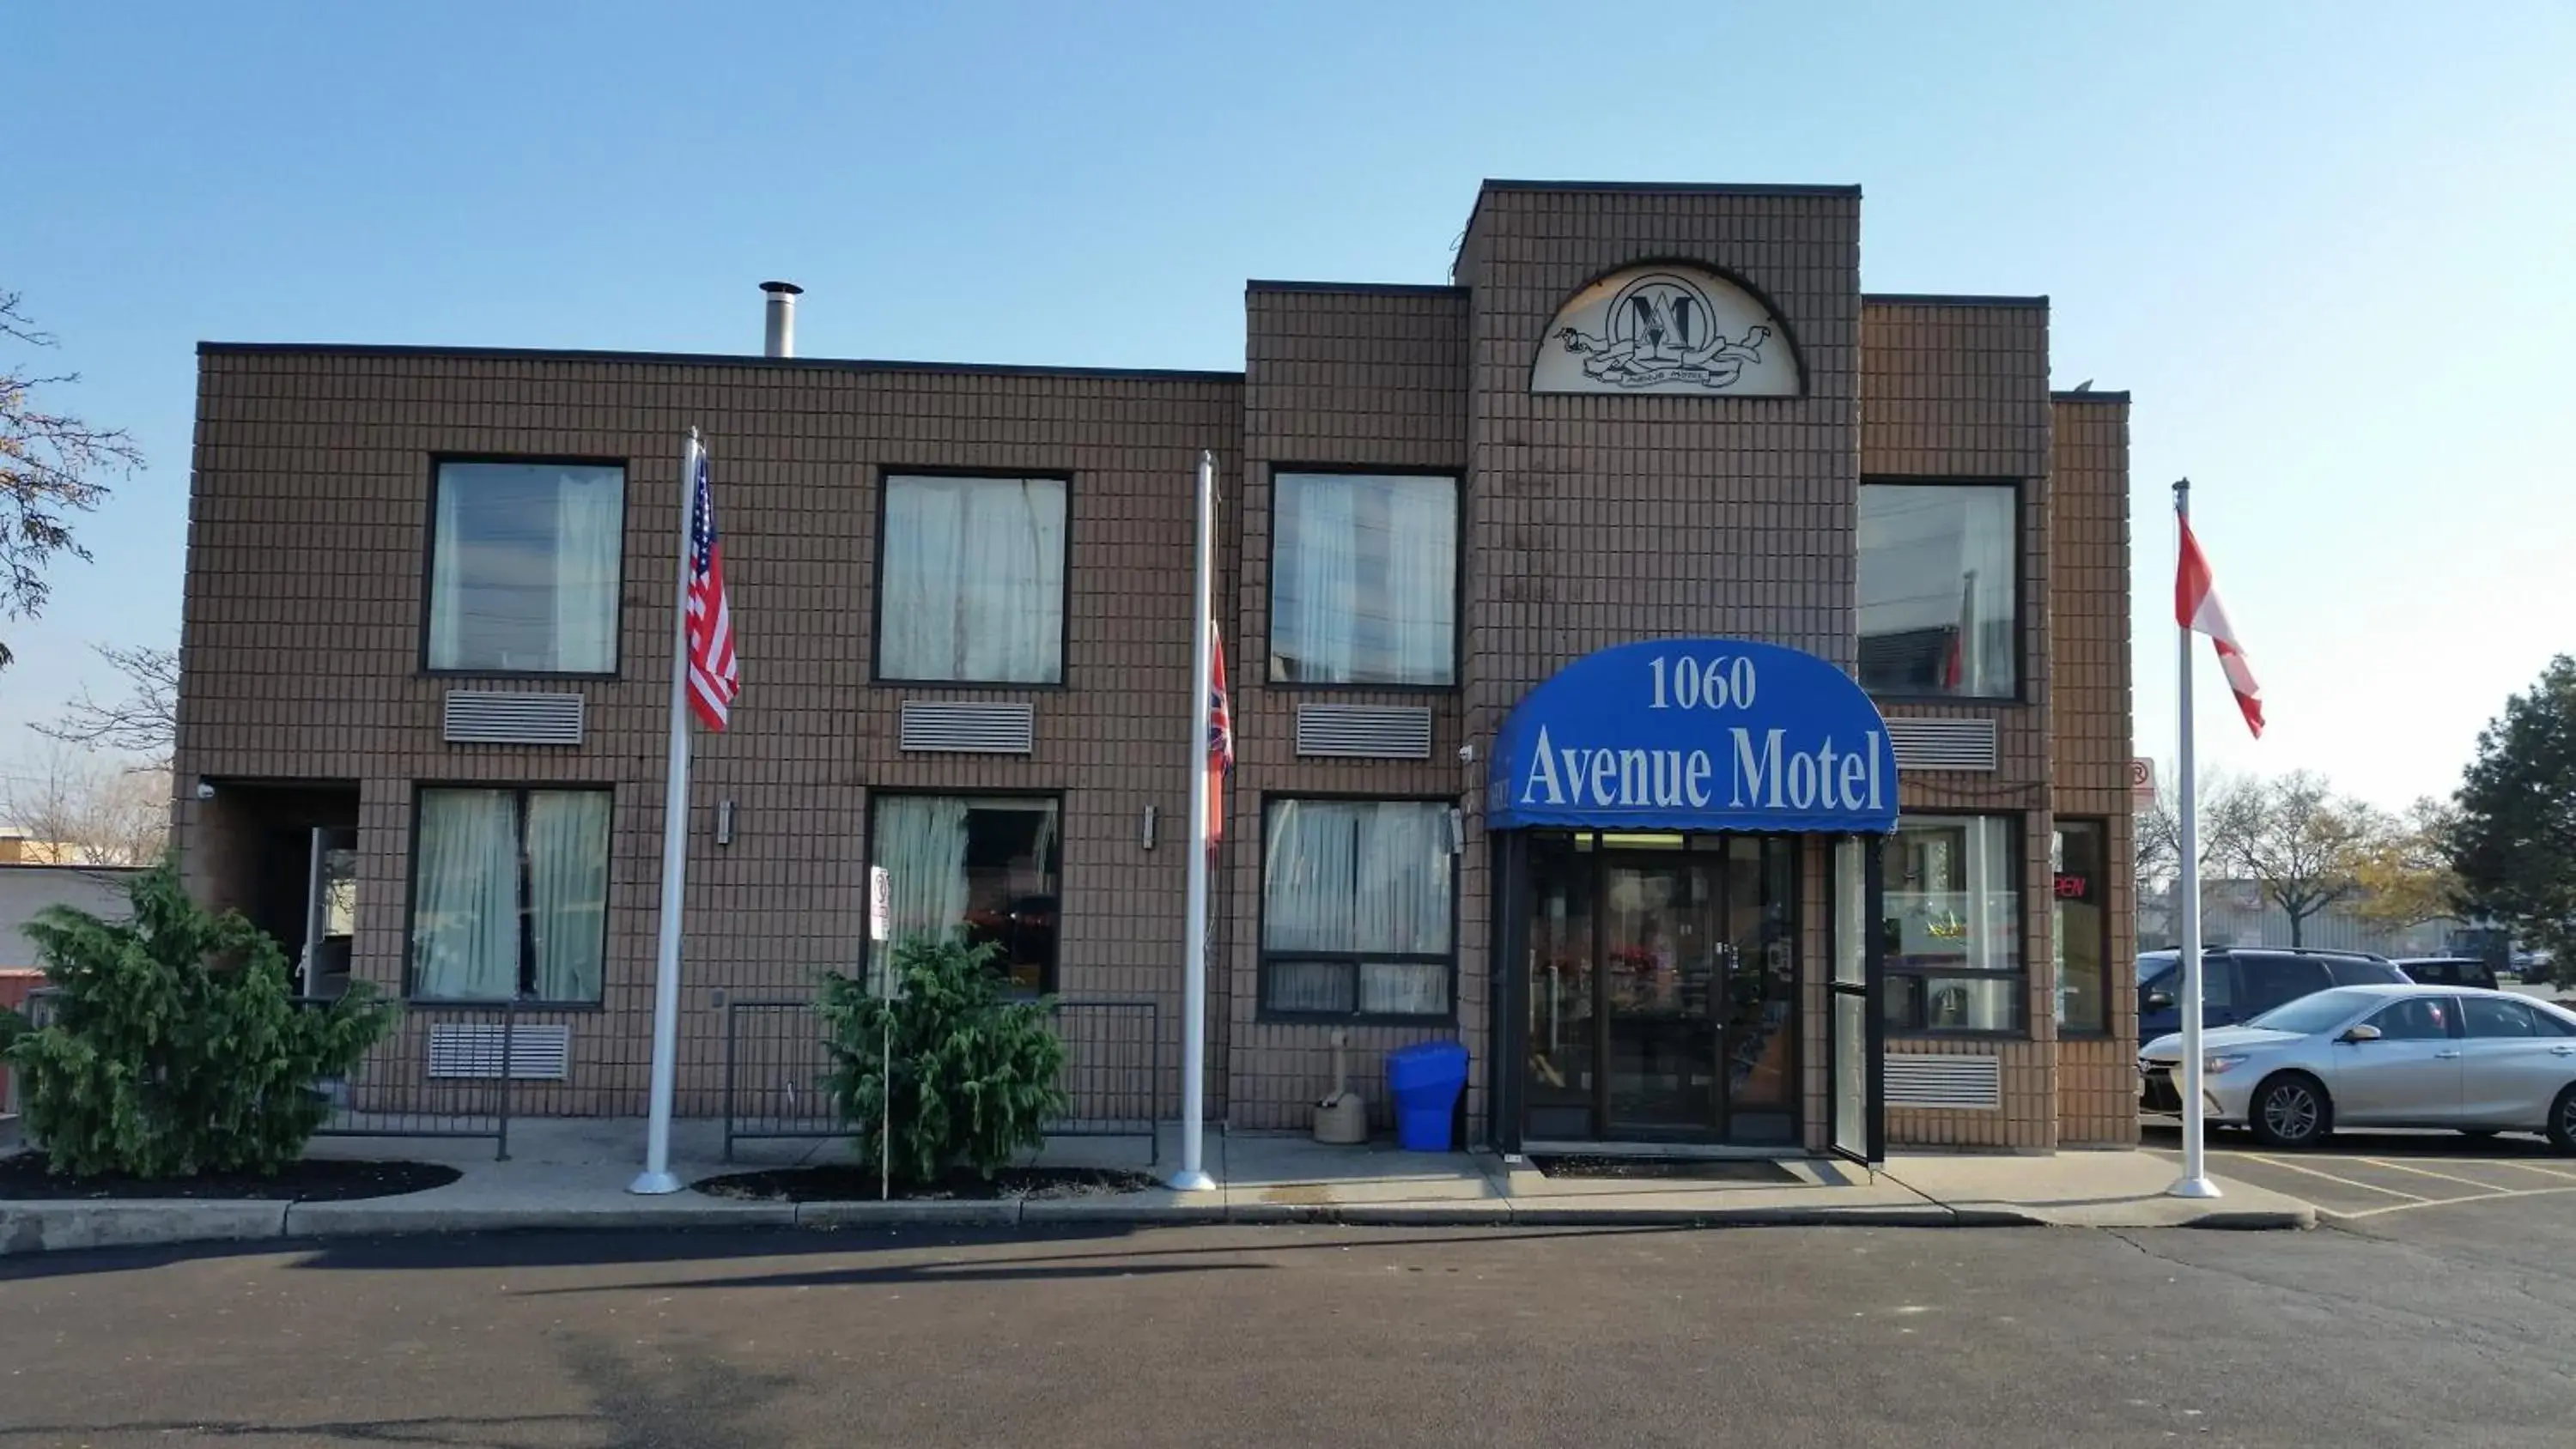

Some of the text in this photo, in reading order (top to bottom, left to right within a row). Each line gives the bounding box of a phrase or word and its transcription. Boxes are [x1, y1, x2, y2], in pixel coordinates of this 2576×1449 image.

[1648, 656, 1757, 710] 1060
[1519, 724, 1711, 808] Avenue
[1728, 726, 1885, 811] Motel
[2054, 876, 2086, 897] PEN
